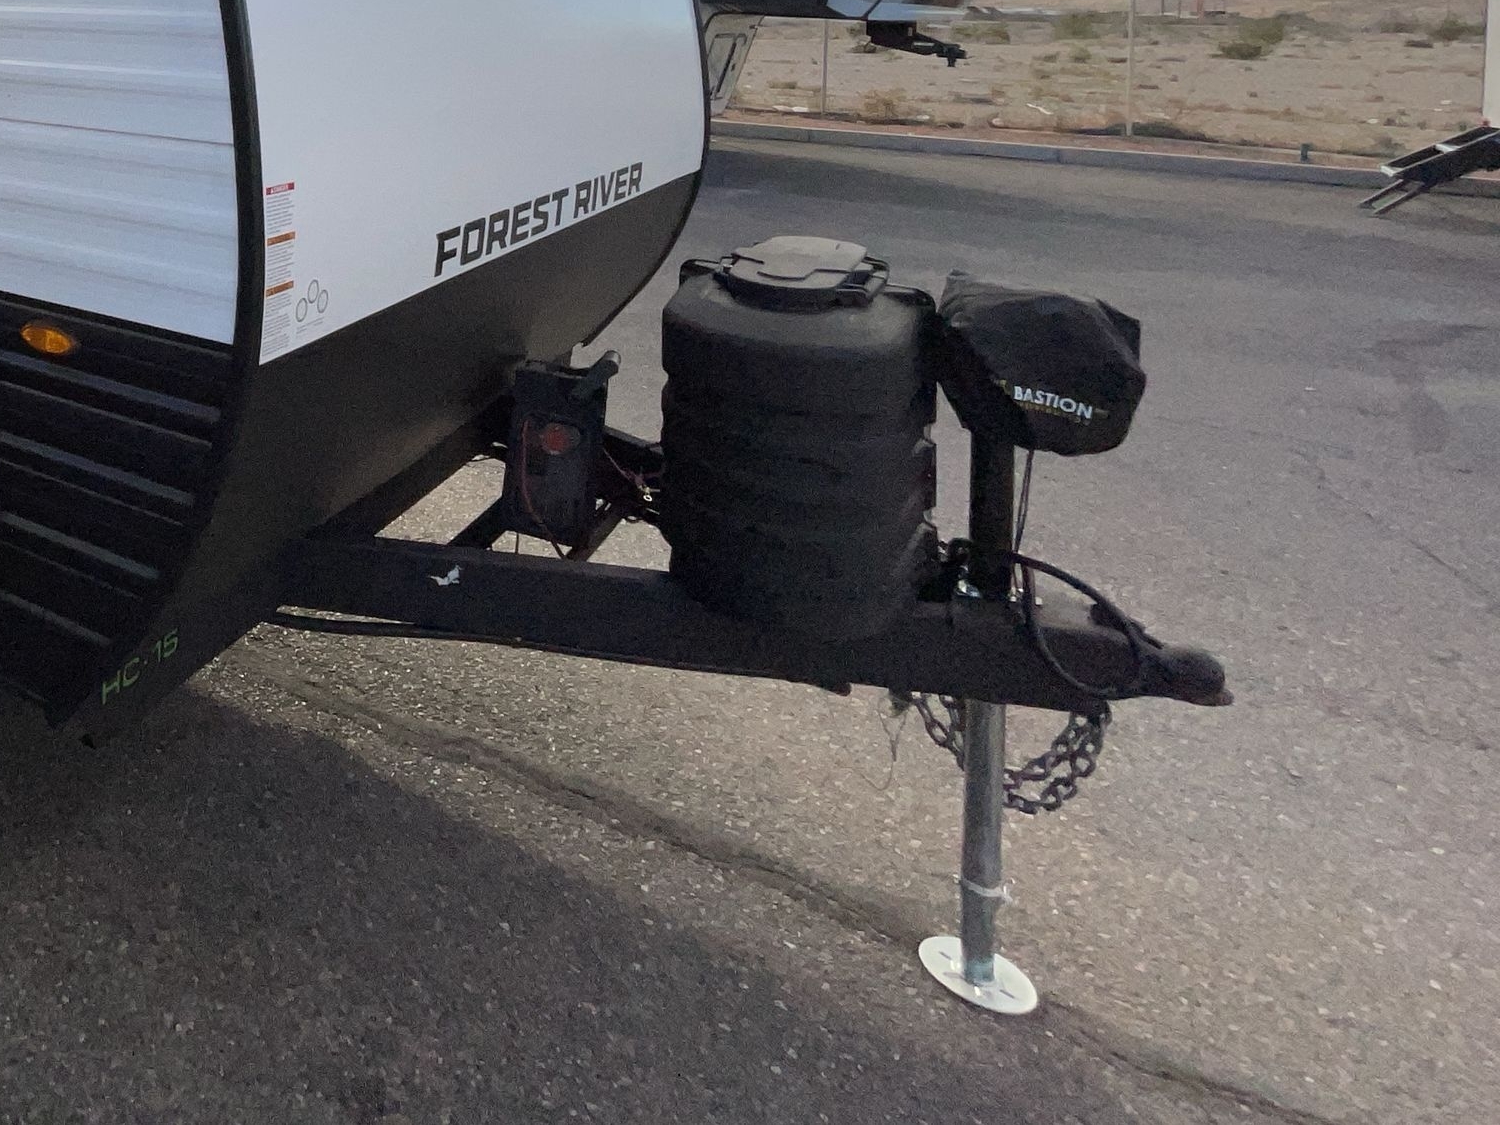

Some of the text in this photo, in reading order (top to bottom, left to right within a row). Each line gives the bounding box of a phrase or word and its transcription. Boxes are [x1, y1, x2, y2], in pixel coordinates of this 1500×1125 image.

[434, 162, 643, 277] FOREST RIVER
[1013, 386, 1093, 419] BASTION
